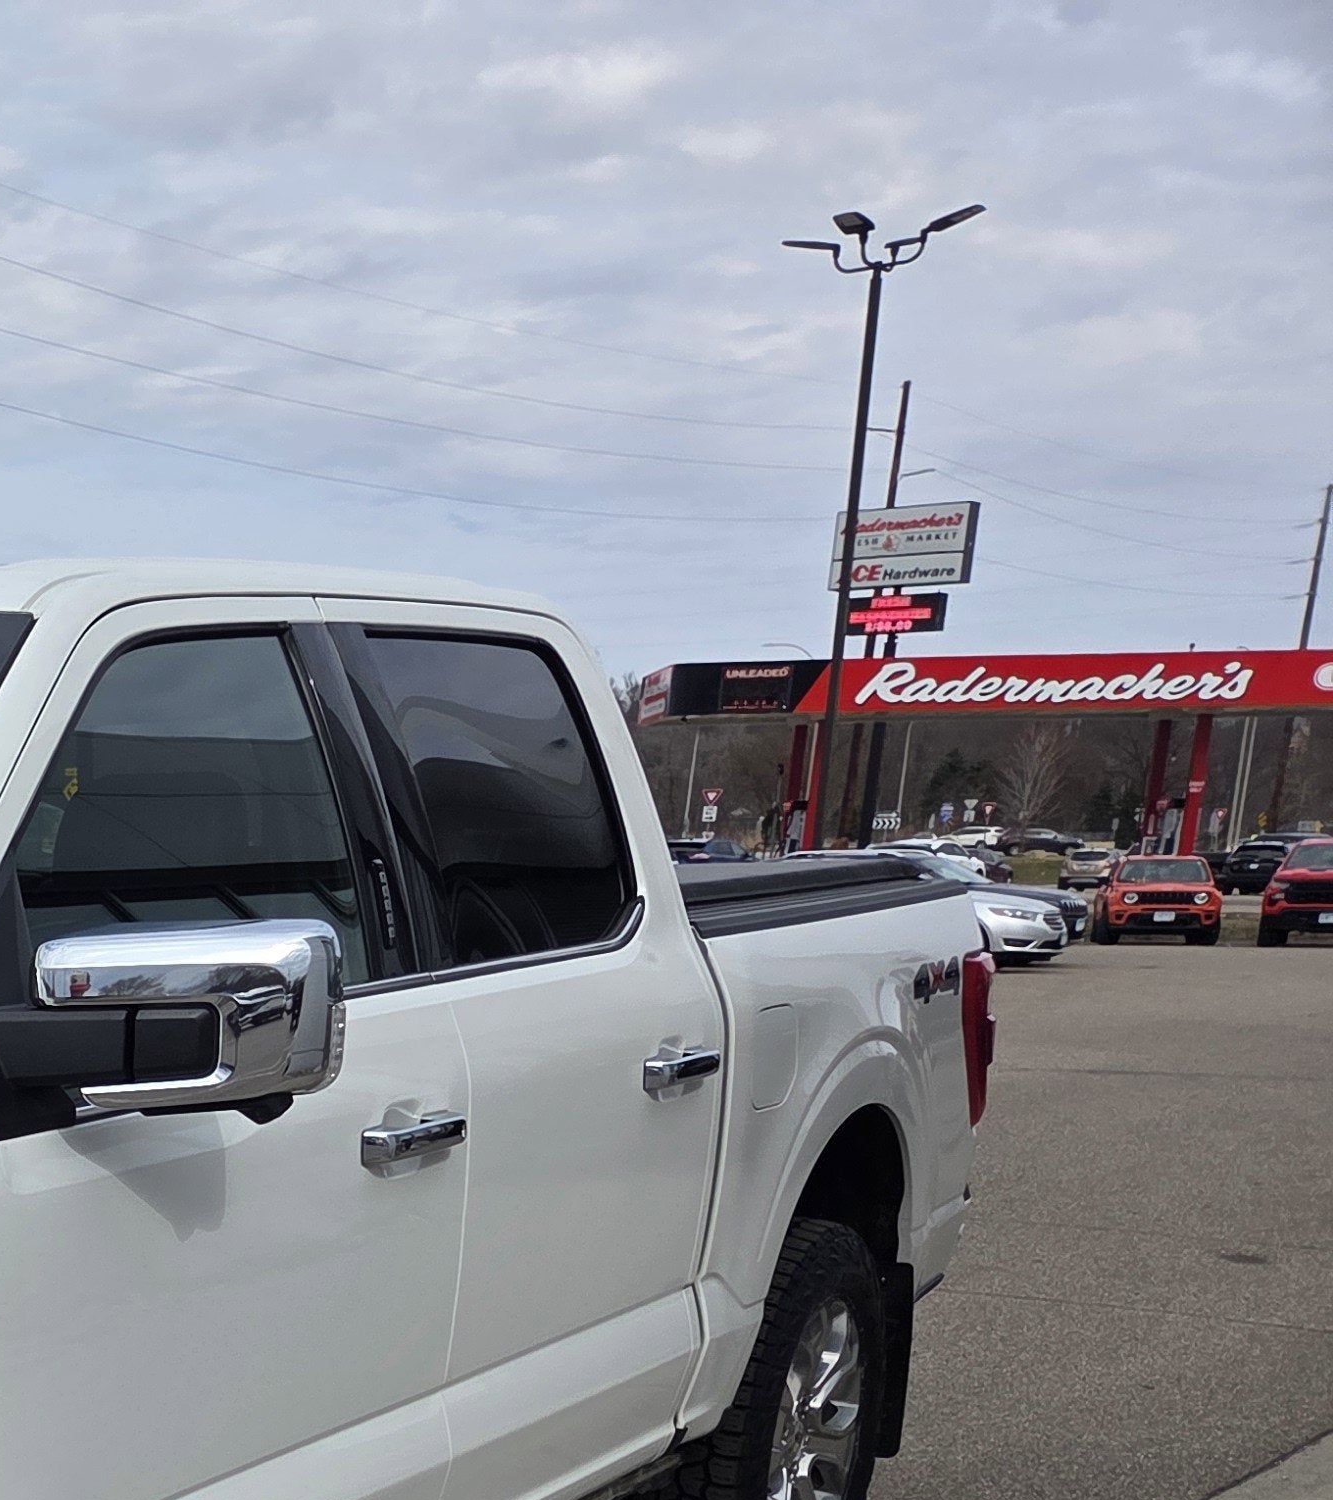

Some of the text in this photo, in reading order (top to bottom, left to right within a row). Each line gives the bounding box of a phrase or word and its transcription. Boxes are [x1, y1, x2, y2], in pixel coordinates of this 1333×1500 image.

[904, 531, 958, 546] MARKET
[837, 564, 956, 584] CE Hardware
[855, 662, 1254, 704] Radermacher's
